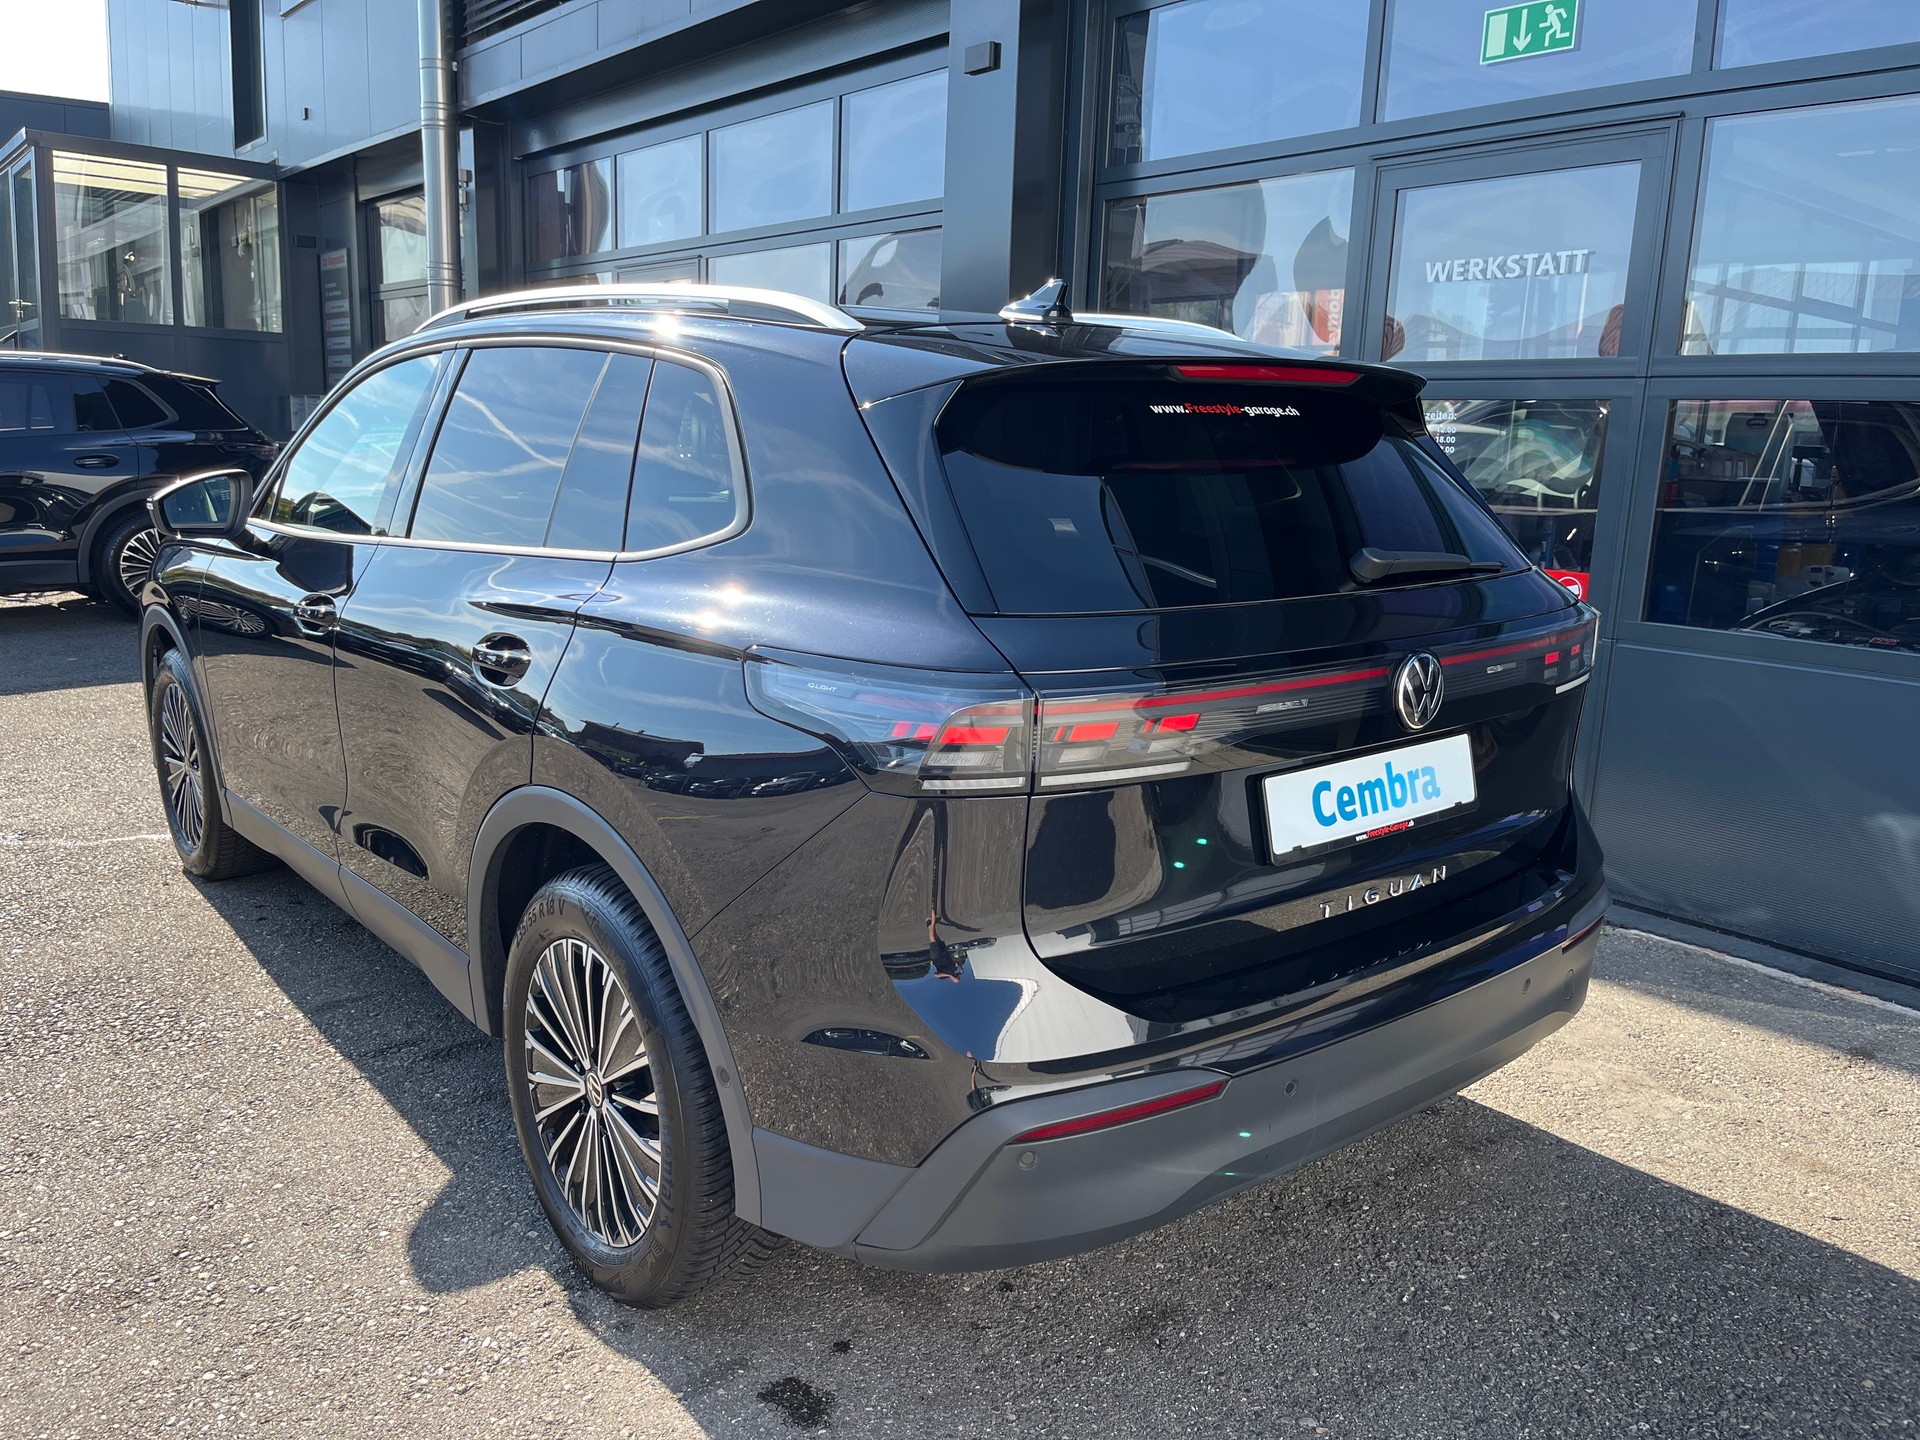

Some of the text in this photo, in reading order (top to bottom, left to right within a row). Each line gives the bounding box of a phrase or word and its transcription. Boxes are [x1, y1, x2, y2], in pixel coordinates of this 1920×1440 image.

[1425, 249, 1589, 283] WERKSTATT
[1149, 403, 1301, 417] www.Freestyle-garage.ch
[1311, 761, 1441, 827] Cembra
[1319, 865, 1446, 918] TIGUAN
